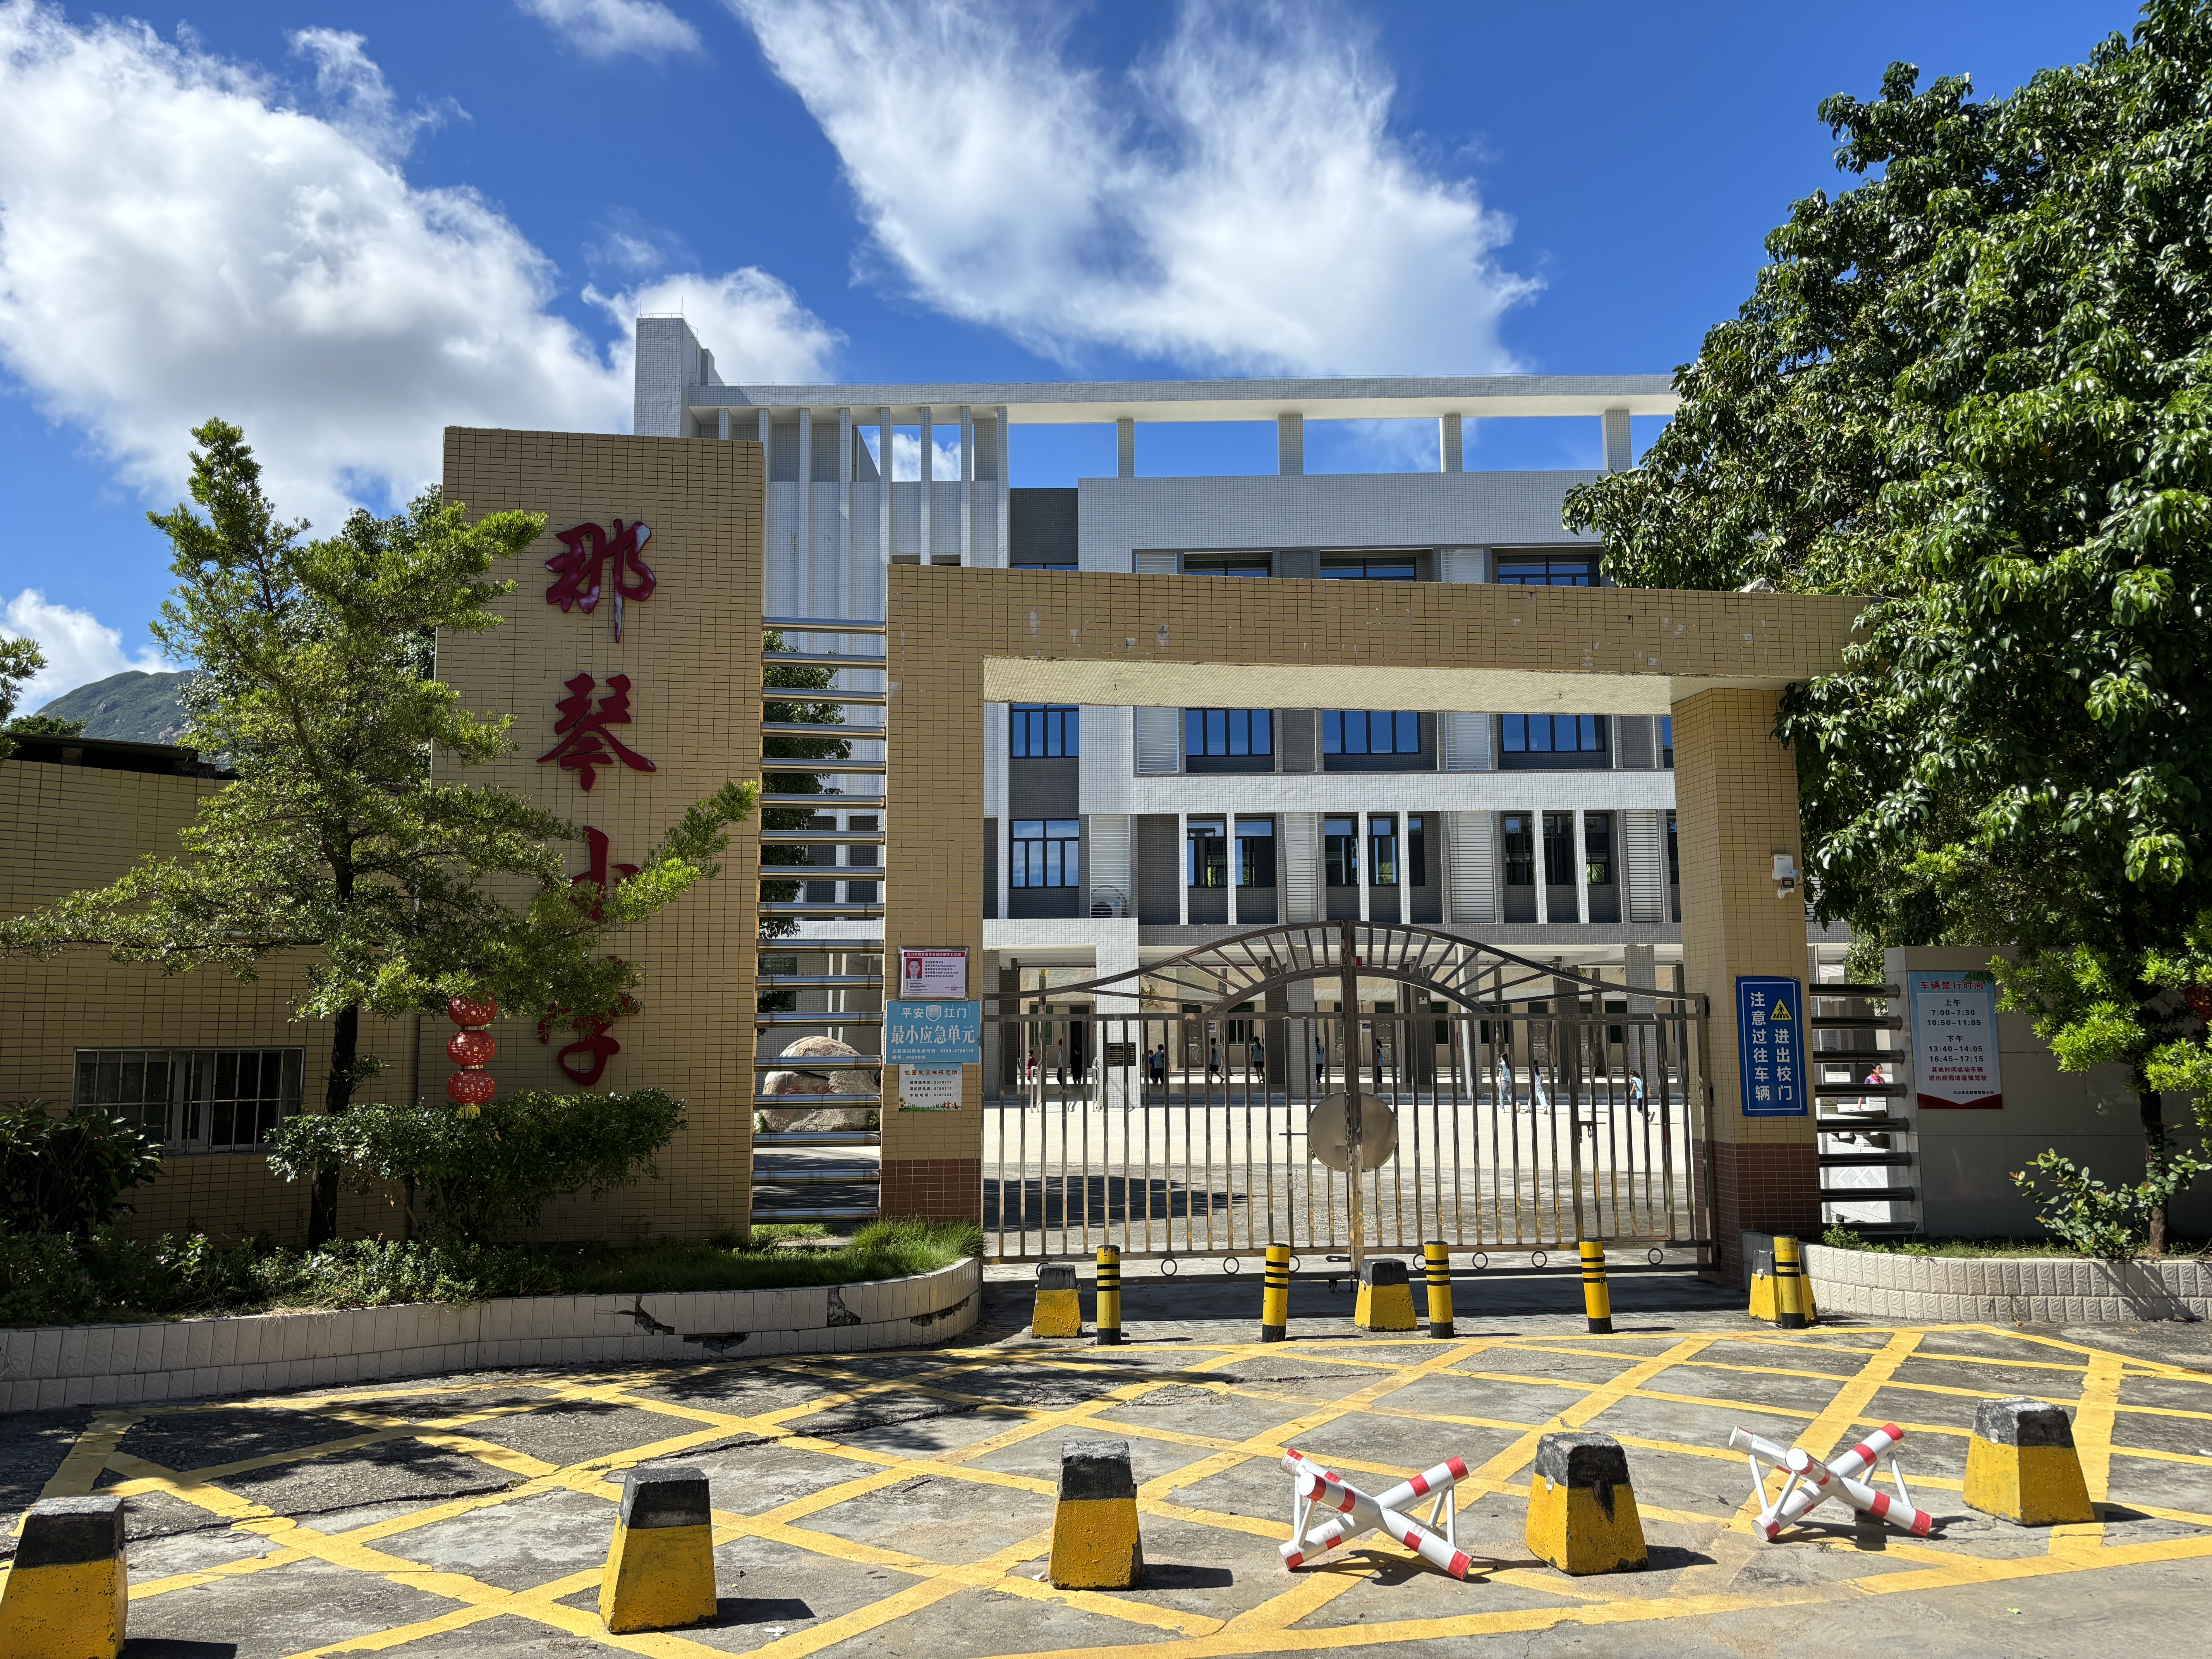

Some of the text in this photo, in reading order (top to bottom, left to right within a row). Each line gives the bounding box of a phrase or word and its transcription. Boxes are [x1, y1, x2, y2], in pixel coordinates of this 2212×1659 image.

[1920, 981, 1984, 990] 车辆禁行时间
[901, 1008, 966, 1018] 平安 江门
[891, 1025, 975, 1044] 最小应急单元
[1750, 992, 1770, 1101] 注意过往车辆
[1775, 1029, 1792, 1101] 进出校门
